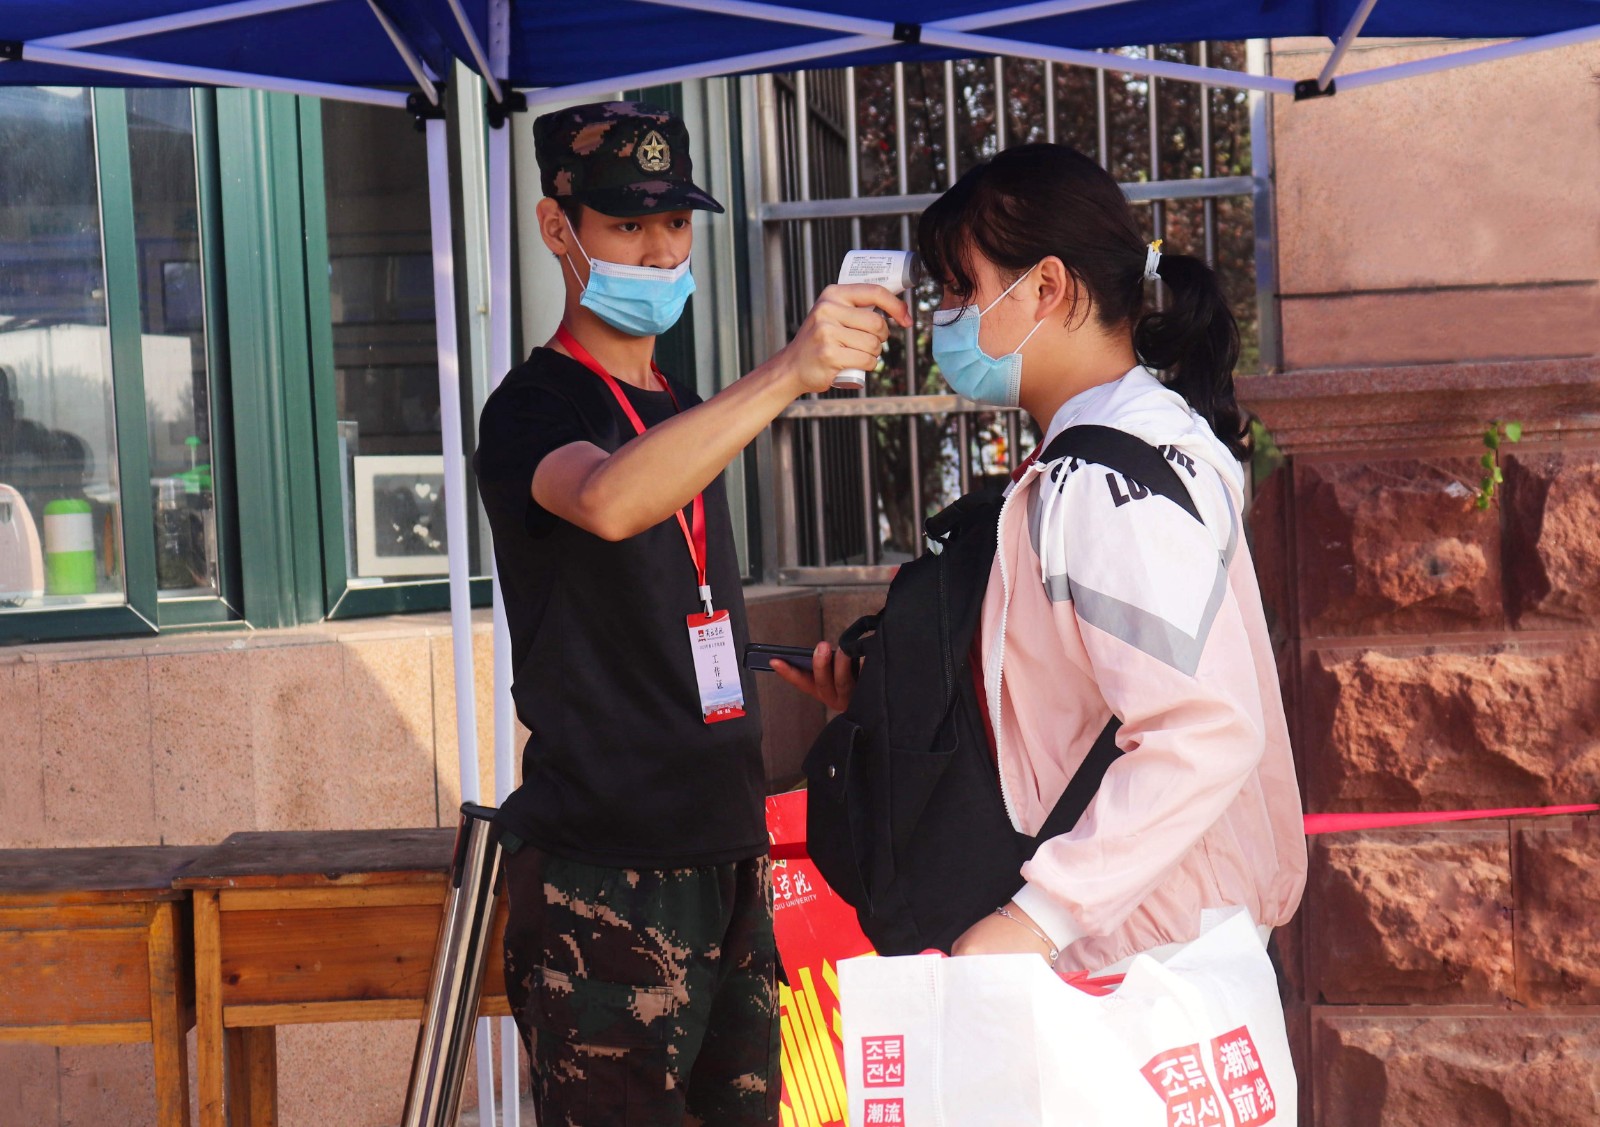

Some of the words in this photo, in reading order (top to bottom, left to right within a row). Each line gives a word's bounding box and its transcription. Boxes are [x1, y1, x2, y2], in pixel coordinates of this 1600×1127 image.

[866, 1040, 901, 1060] 조류
[1220, 1037, 1259, 1081] 潮流
[867, 1063, 902, 1083] 전선
[1152, 1054, 1206, 1098] 조류
[867, 1102, 901, 1123] 潮流
[1228, 1077, 1274, 1124] 前线
